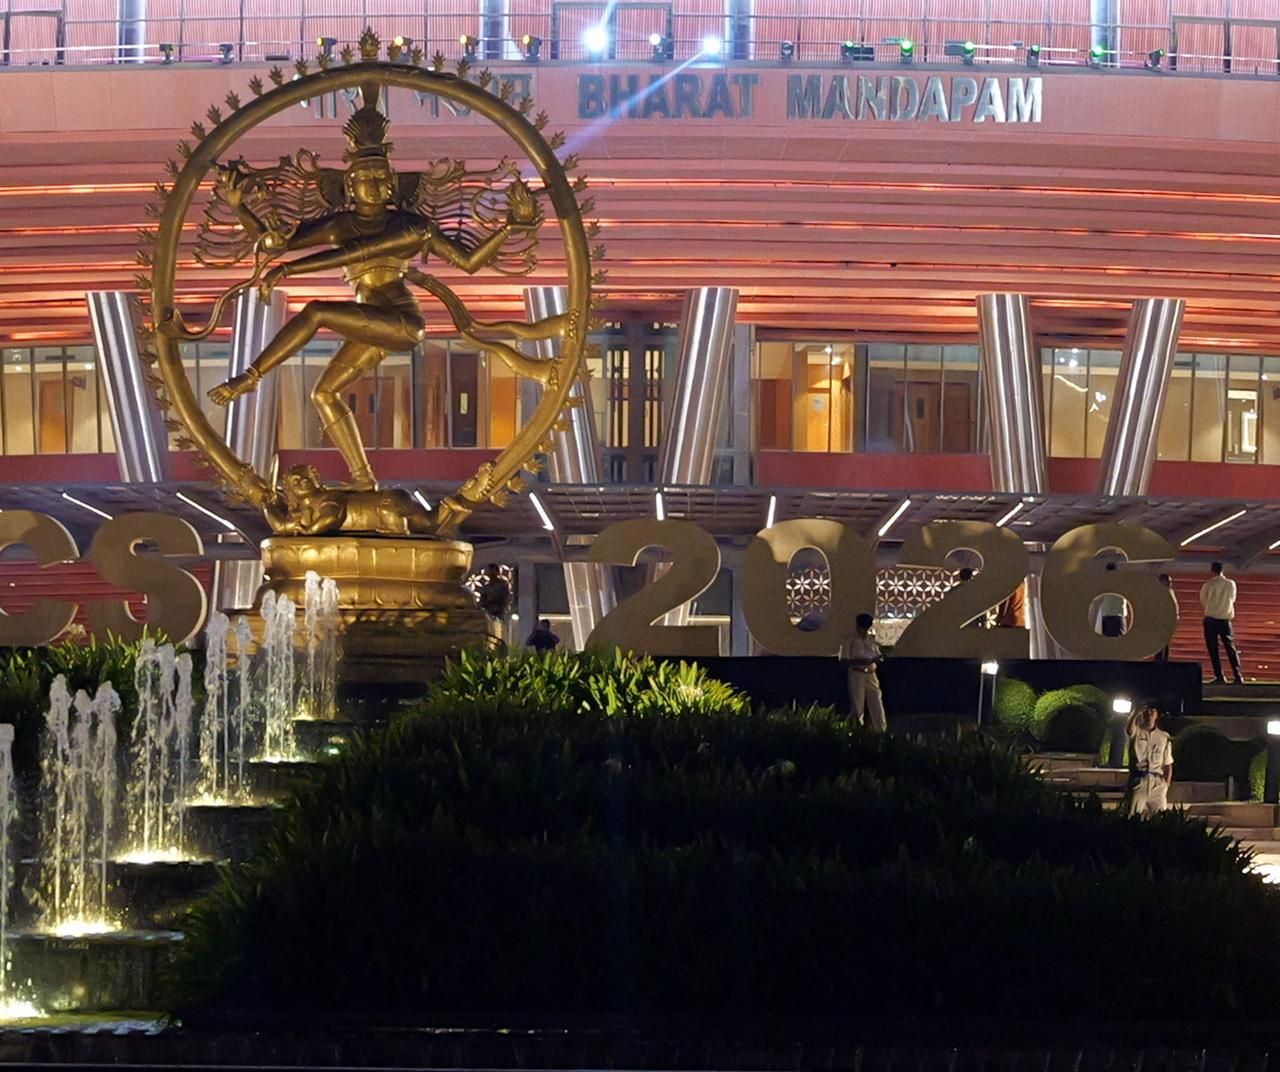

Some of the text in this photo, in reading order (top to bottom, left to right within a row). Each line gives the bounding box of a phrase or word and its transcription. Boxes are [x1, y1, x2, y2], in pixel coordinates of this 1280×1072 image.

[577, 73, 761, 119] BHARAT
[786, 74, 1043, 123] MANDAPAM
[582, 518, 1182, 660] 2026
